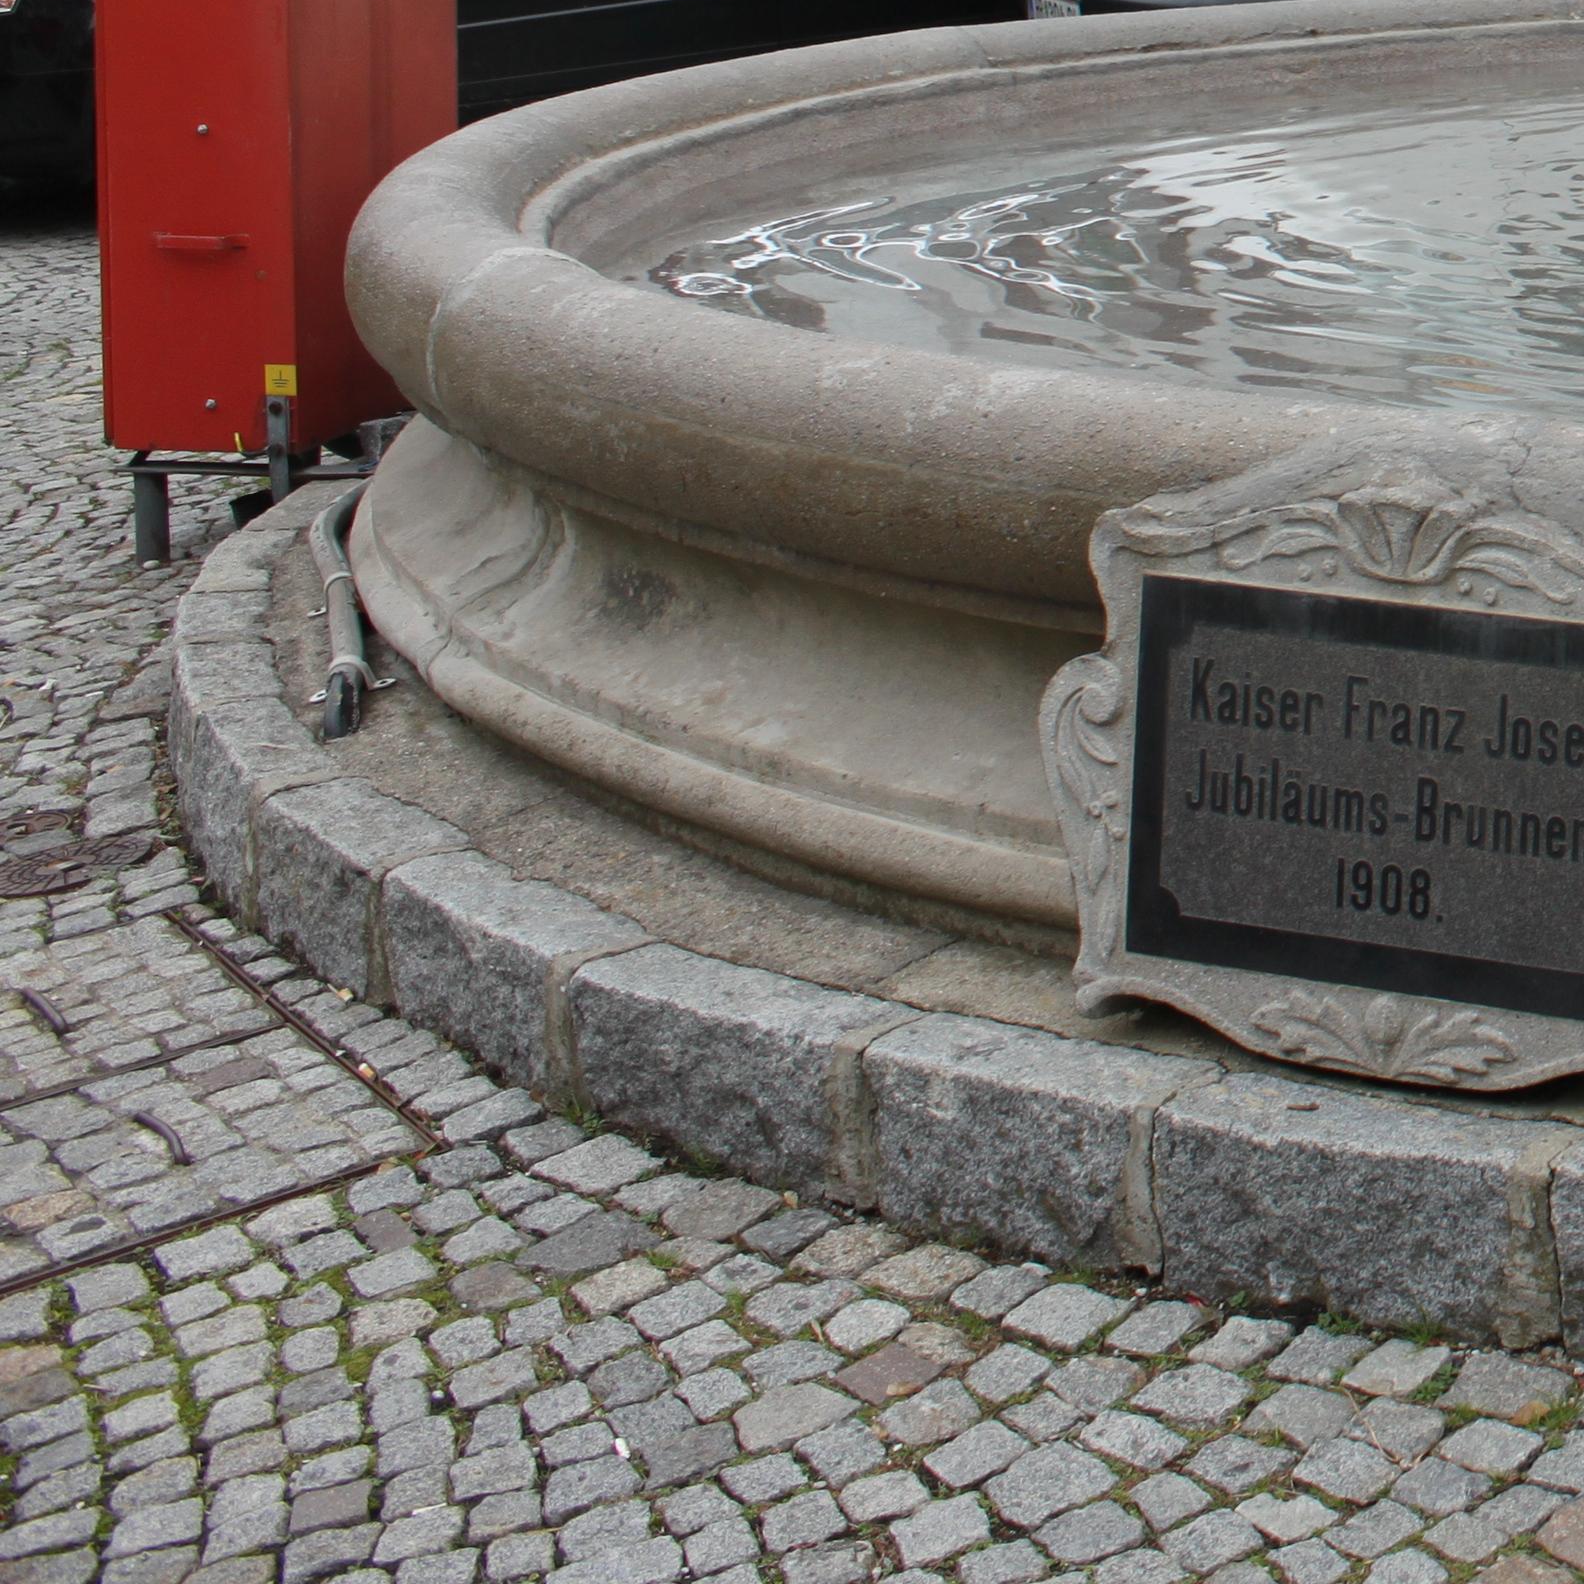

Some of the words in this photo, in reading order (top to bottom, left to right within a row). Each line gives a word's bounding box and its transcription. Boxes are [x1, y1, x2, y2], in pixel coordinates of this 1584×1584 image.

[1190, 656, 1323, 735] Kaiser
[1344, 675, 1467, 755] Franz
[1335, 857, 1444, 924] 1908.
